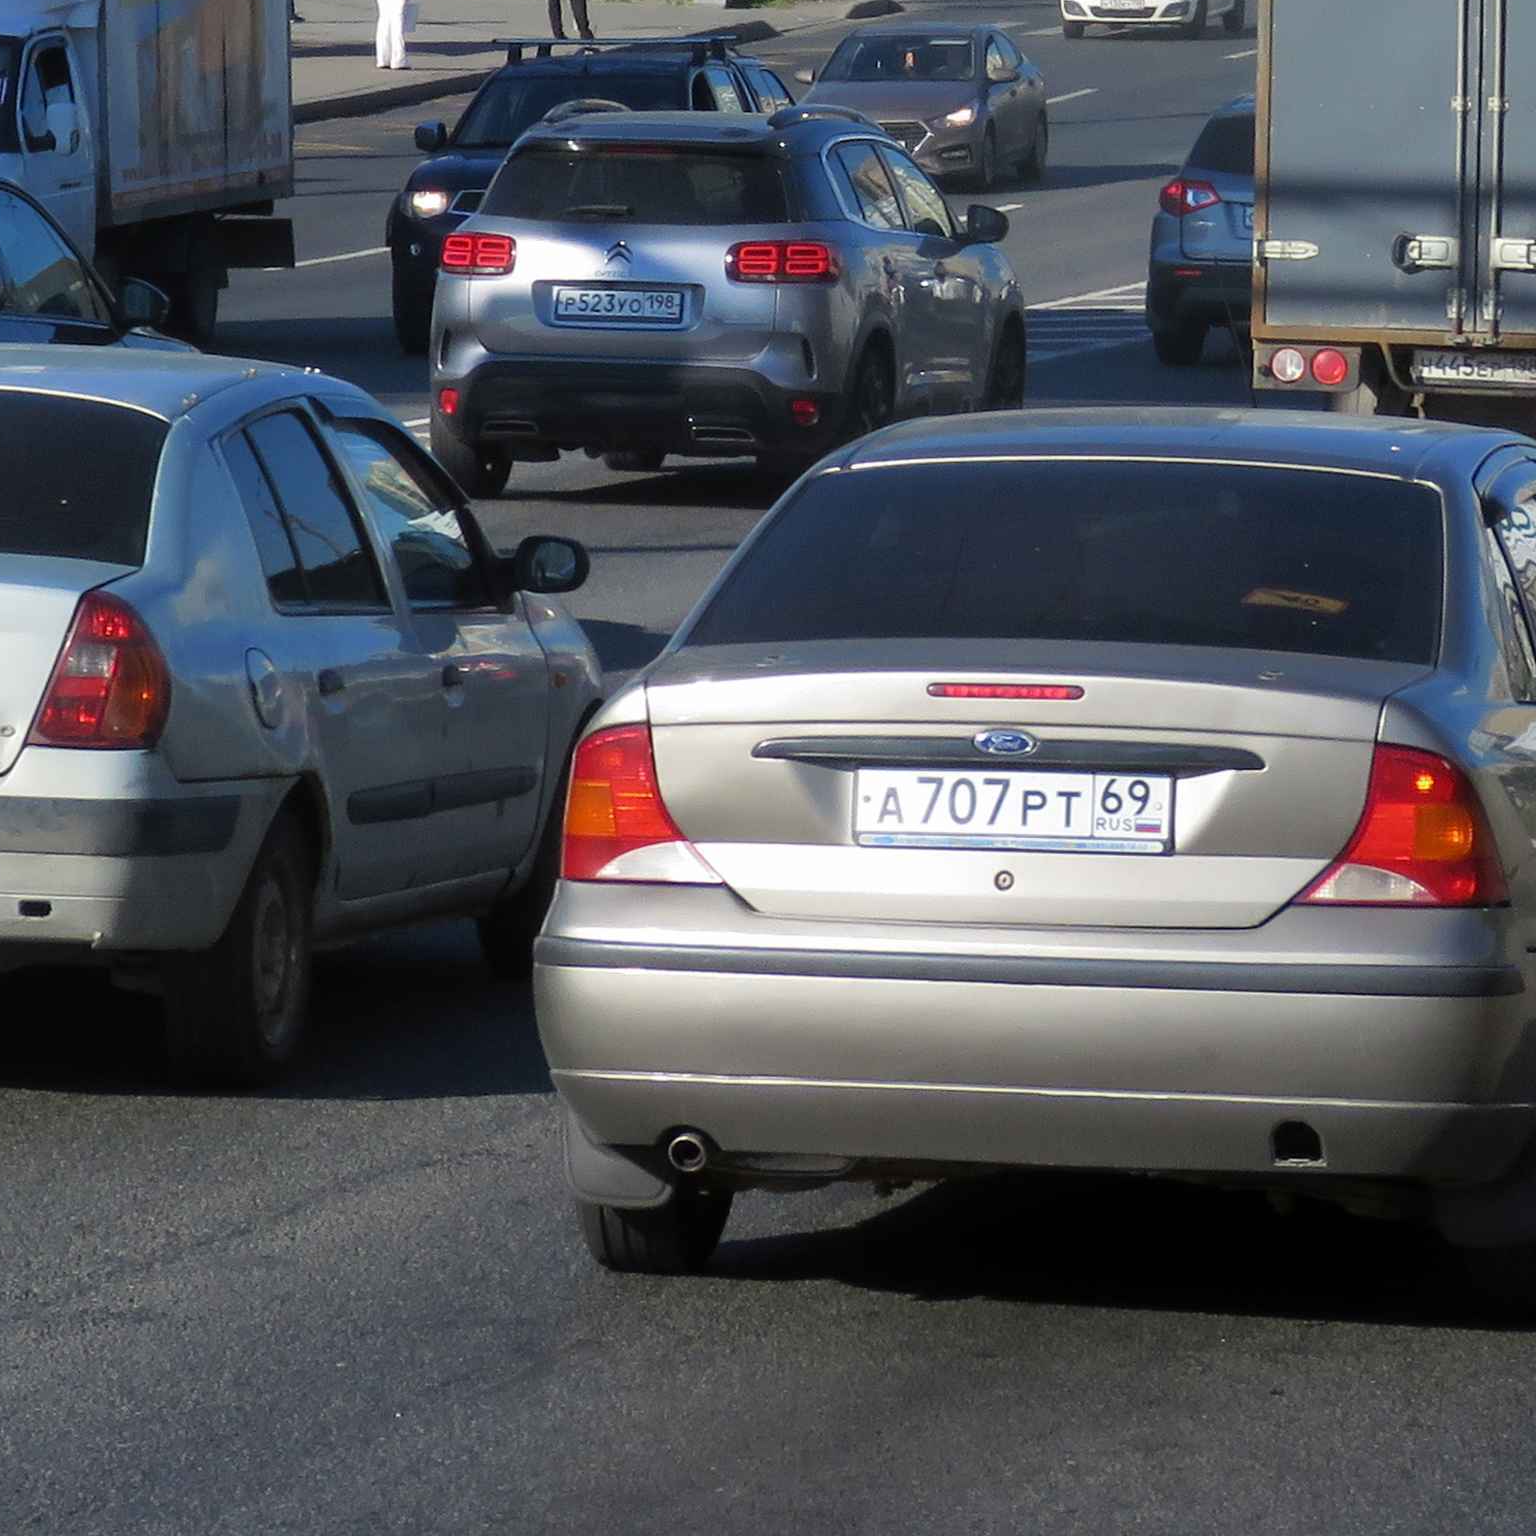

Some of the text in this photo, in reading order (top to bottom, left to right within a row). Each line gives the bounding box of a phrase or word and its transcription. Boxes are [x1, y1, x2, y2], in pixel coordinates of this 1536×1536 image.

[564, 293, 674, 314] Р523УО 198
[876, 775, 1151, 828] А707РТ 69
[1095, 816, 1133, 832] RUS
